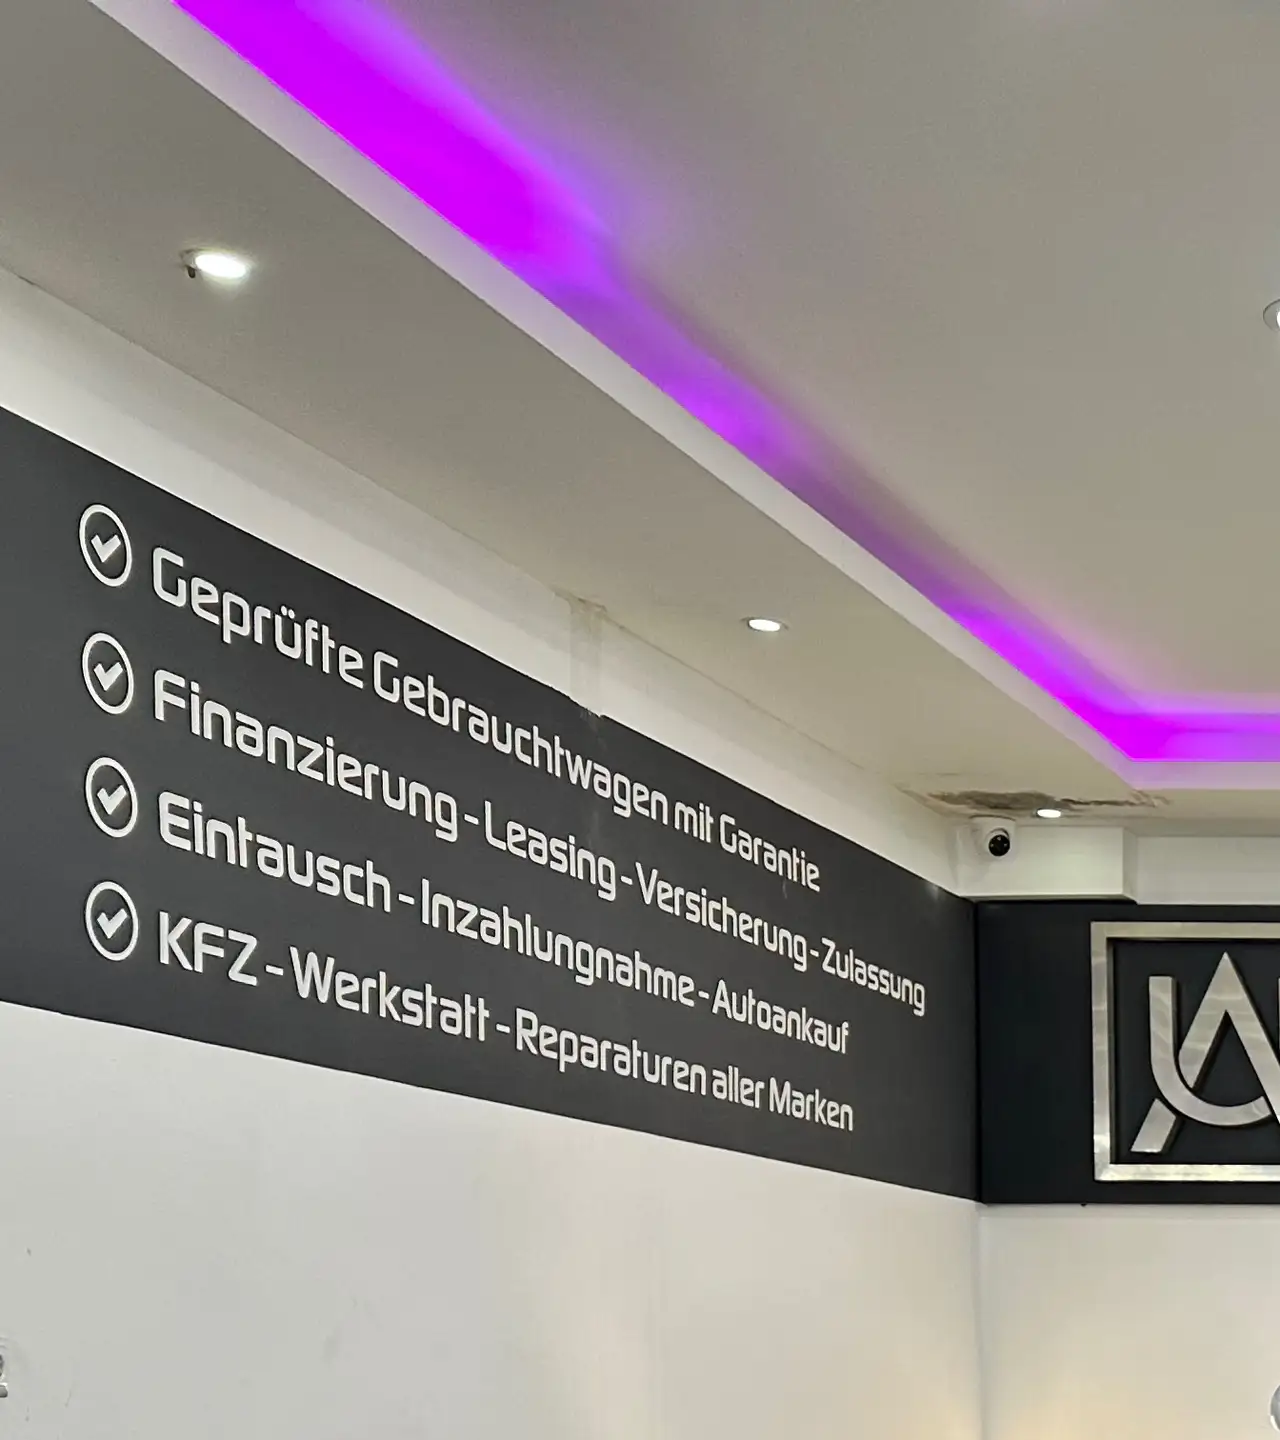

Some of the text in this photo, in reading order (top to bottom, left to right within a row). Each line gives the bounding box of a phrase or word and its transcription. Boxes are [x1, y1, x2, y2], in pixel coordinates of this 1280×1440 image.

[153, 547, 820, 892] Geprüfte Gebrauchtwagen mit Garantie
[154, 669, 458, 843] Finanzierung
[484, 800, 616, 902] Leasing
[635, 862, 807, 973] Versicherung
[821, 937, 925, 1017] Zulassung
[158, 791, 391, 913] Eintausch
[421, 878, 695, 1008] Inzahlungnahme
[711, 979, 849, 1054] Autoankauf
[159, 911, 258, 986] KFZ
[289, 946, 490, 1042] Werkstatt
[515, 1007, 706, 1096] Reparaturen
[712, 1065, 765, 1109] aller
[769, 1077, 853, 1132] Marken
